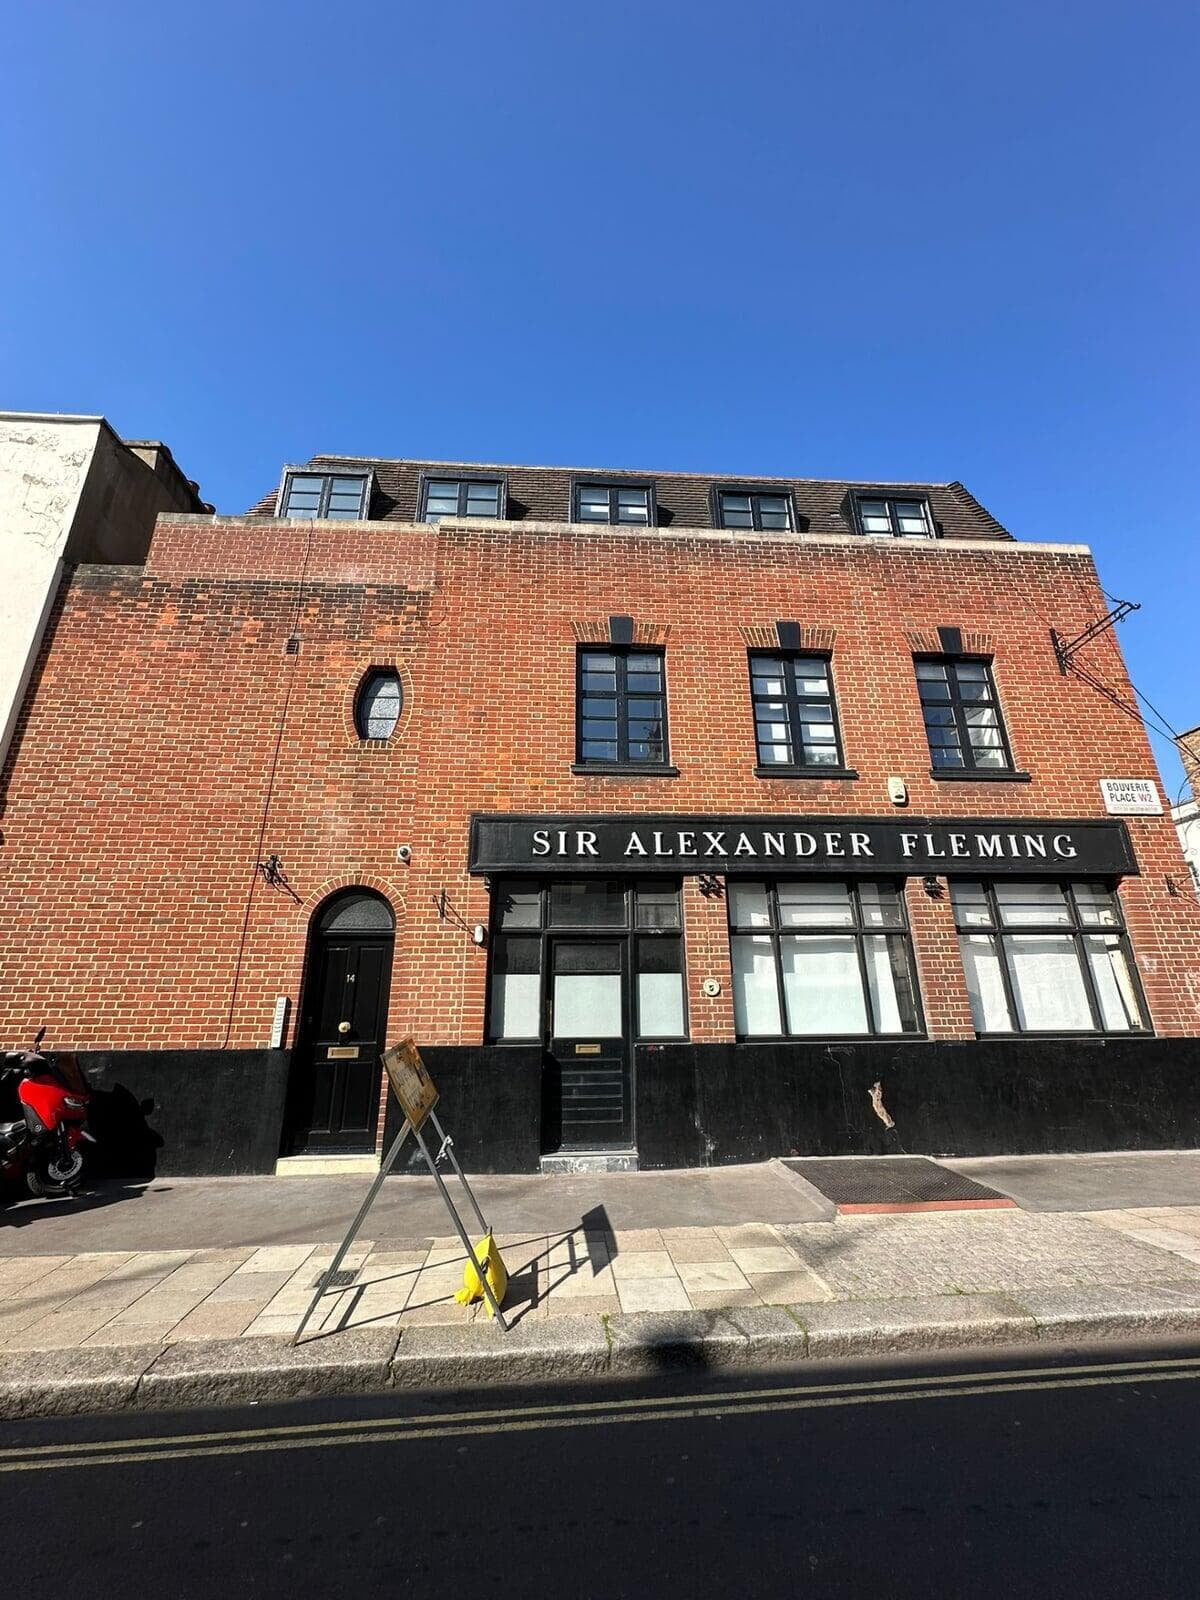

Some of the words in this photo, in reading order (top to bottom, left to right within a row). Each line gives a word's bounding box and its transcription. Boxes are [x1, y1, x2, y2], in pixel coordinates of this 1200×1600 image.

[1106, 782, 1151, 792] BOUVERIE
[1109, 792, 1137, 803] PLACE
[1138, 793, 1154, 803] W2
[532, 830, 600, 856] SIR
[623, 831, 875, 857] ALEXANDER
[899, 833, 1078, 859] FLEMING
[346, 974, 356, 983] 14
